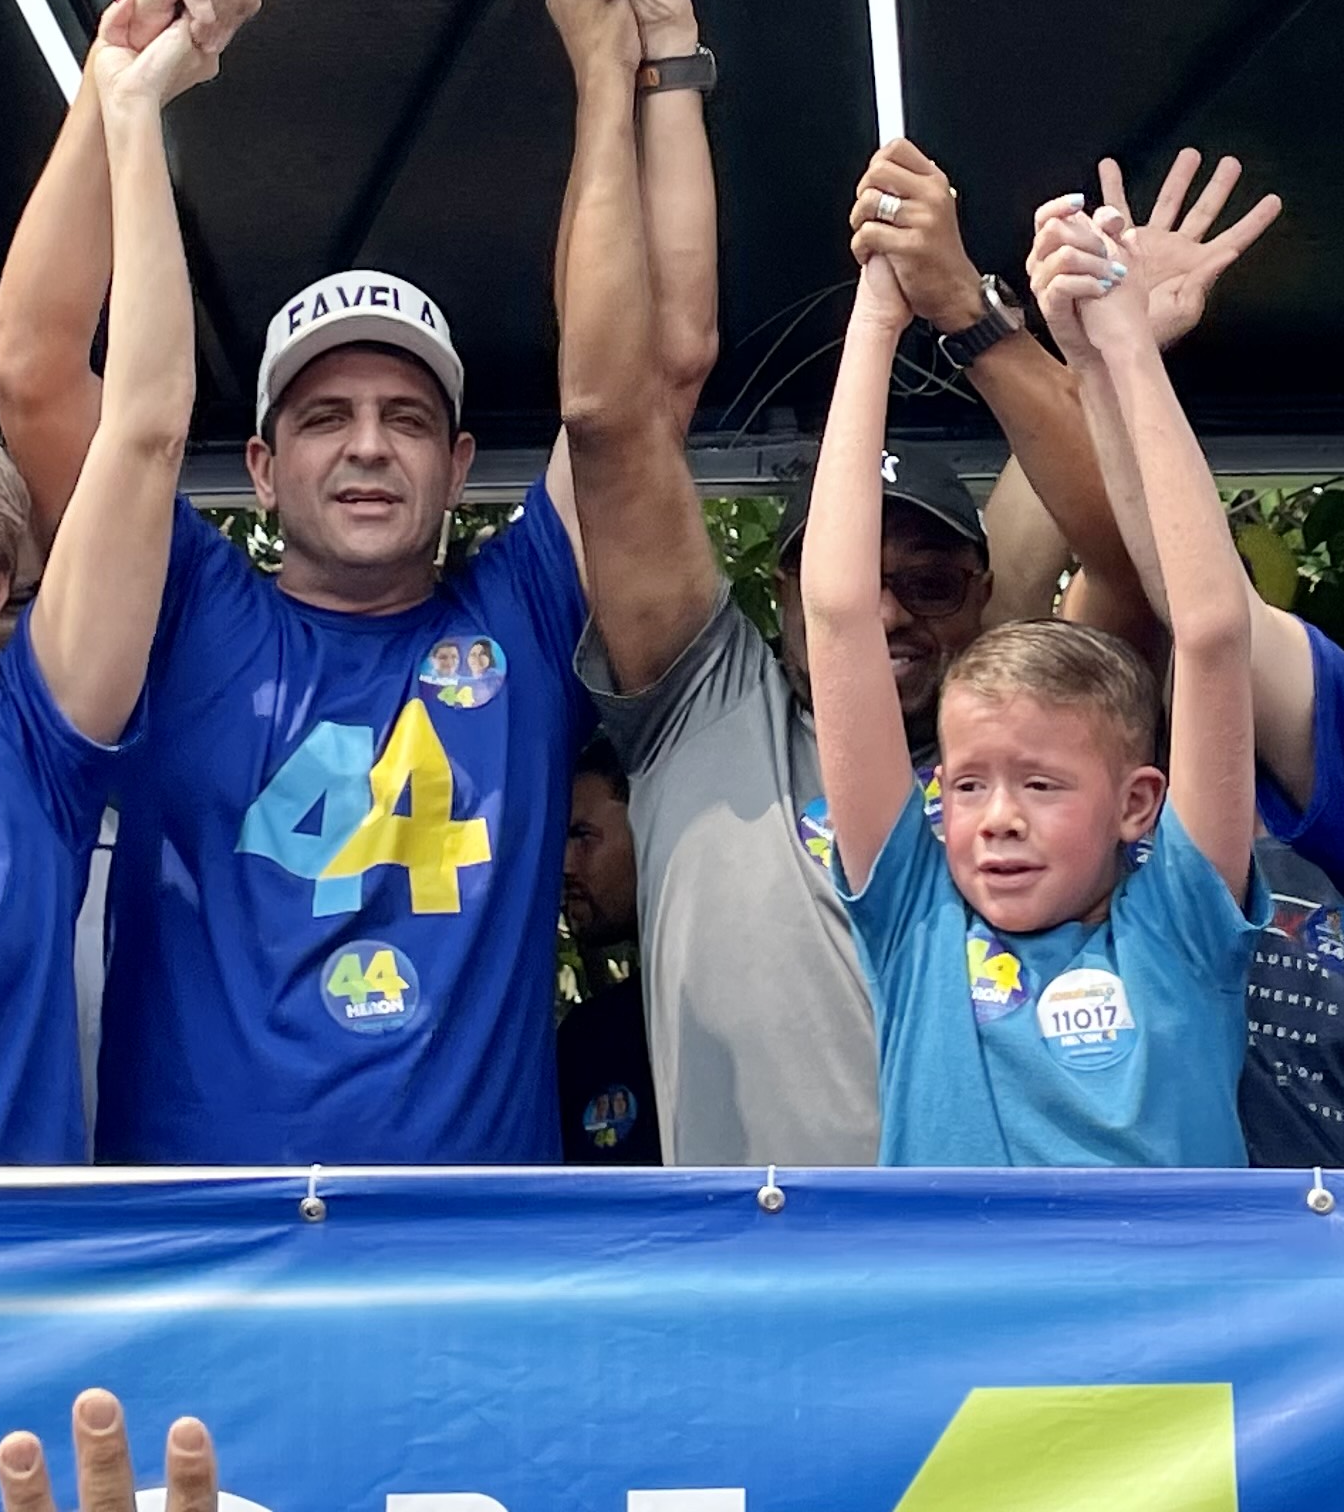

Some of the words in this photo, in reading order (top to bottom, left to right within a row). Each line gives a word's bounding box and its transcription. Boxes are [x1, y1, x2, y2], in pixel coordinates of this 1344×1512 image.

[287, 285, 437, 336] FAVELA
[234, 698, 492, 917] 44
[327, 950, 410, 1005] 44
[1051, 1005, 1118, 1033] 11017
